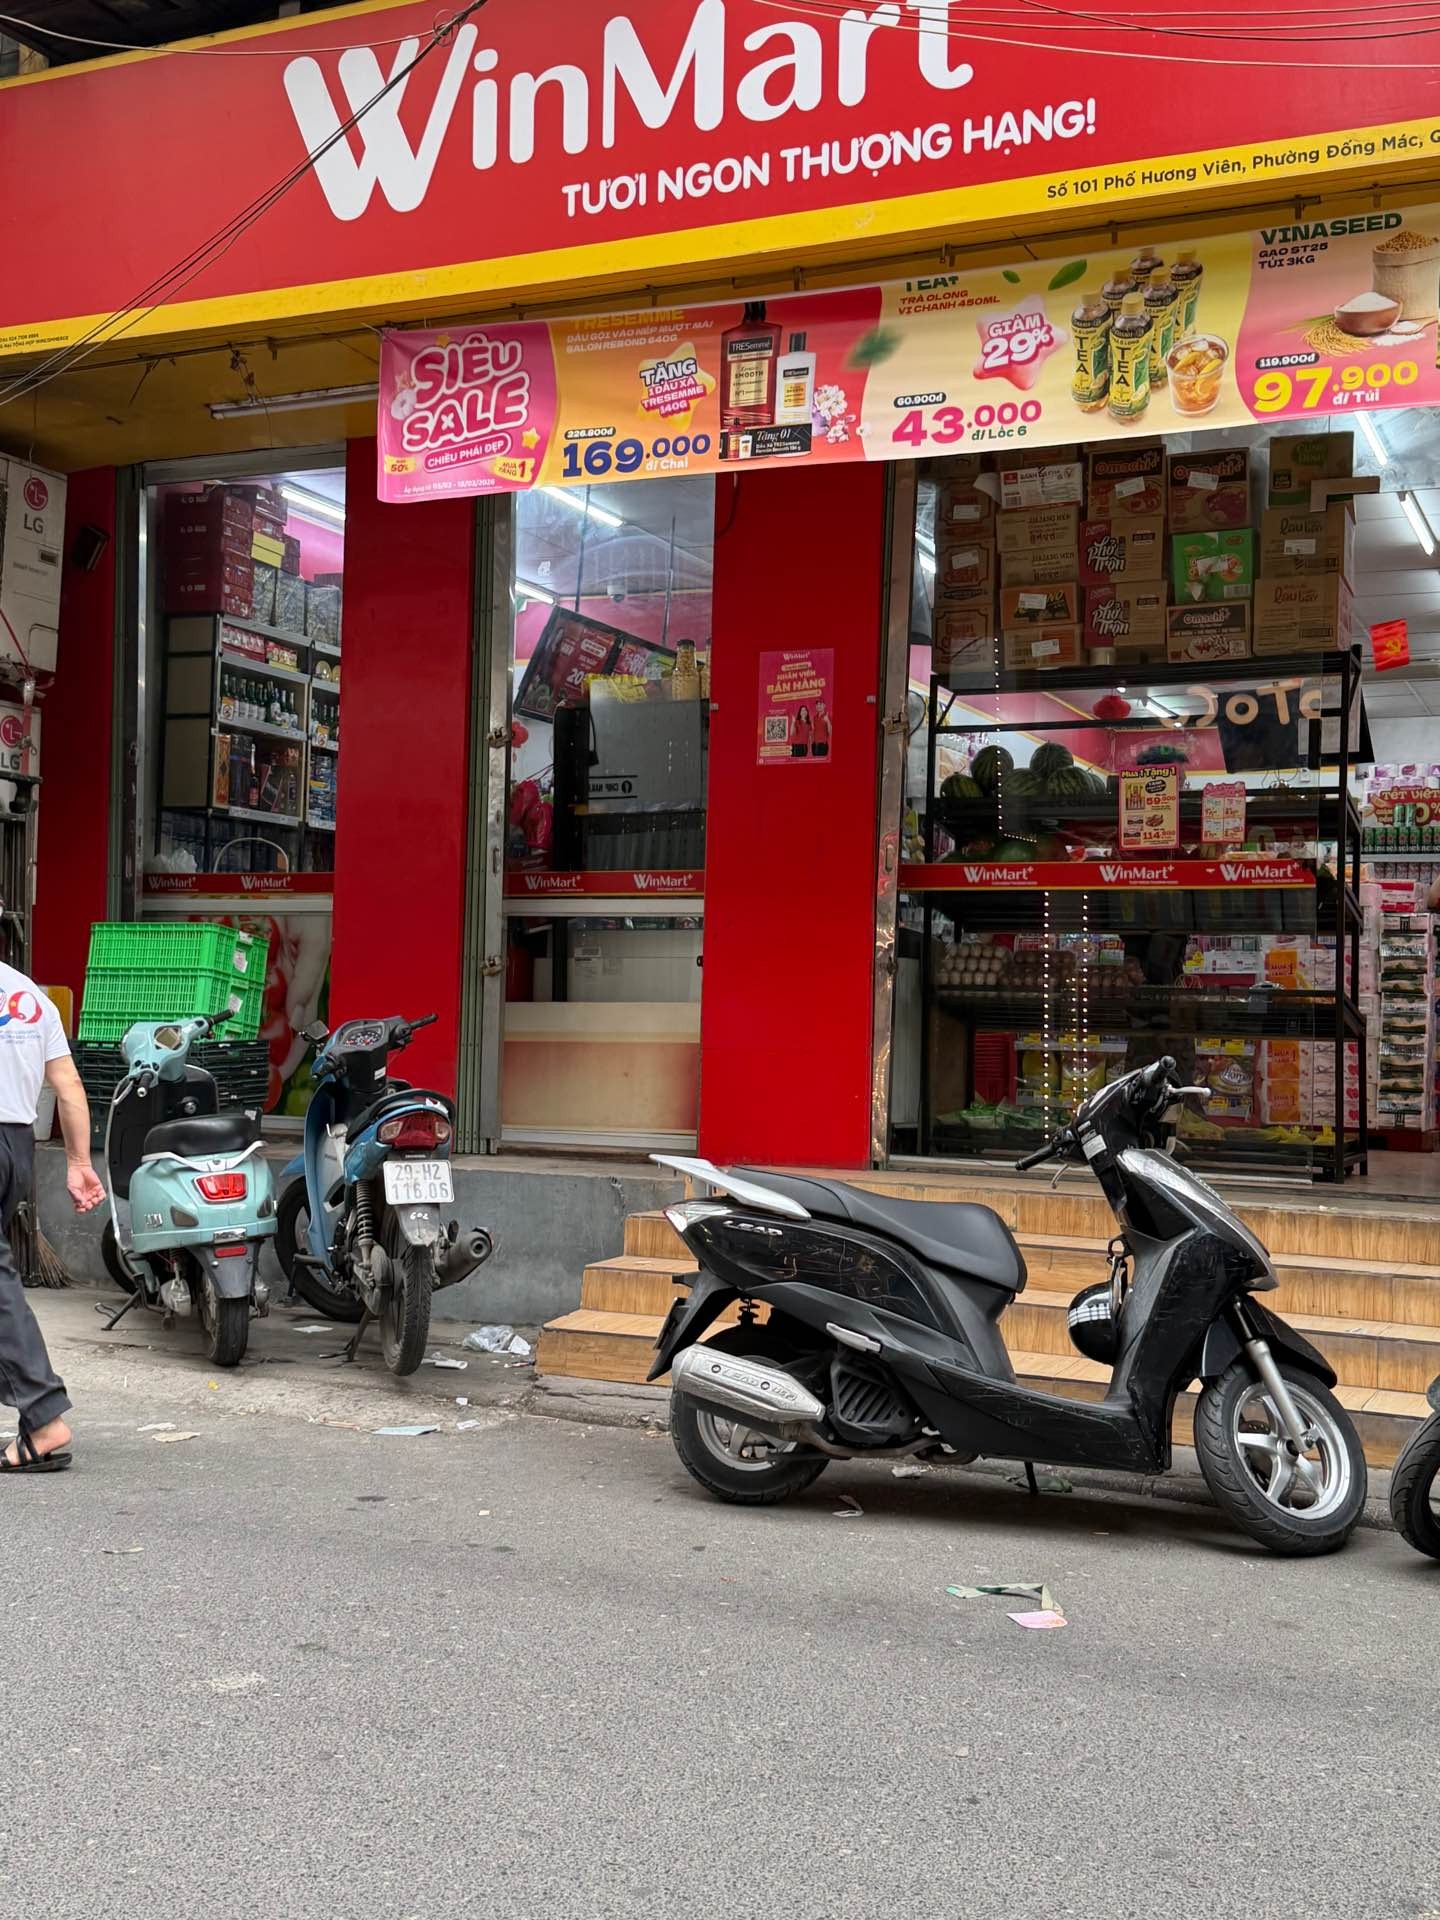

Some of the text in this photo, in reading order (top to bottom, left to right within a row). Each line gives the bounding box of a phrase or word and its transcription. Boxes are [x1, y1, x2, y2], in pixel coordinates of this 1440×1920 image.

[283, 0, 974, 221] WinMart
[562, 97, 1097, 217] TƯƠI NGON THƯỢNG HẠNG!
[1047, 180, 1068, 198] Số
[1073, 178, 1098, 195] 101
[1104, 170, 1136, 191] Phố
[1141, 165, 1197, 186] Hương
[1203, 158, 1247, 177] Viên,
[1252, 147, 1320, 170] Phường
[1382, 133, 1424, 153] Mác,
[1260, 213, 1403, 245] VINASEED
[1291, 242, 1328, 254] ST25
[1287, 255, 1315, 266] 3KG
[914, 301, 957, 314] CHANH
[957, 295, 1000, 308] 450ML
[566, 342, 602, 354] SALON
[983, 326, 1050, 369] 29%
[413, 333, 522, 407] SIÊU
[640, 358, 698, 386] TẶNG
[641, 385, 705, 409] TRESEMME
[1253, 359, 1419, 413] 97.900
[1352, 388, 1380, 403] Túi
[402, 371, 530, 452] SALE
[659, 400, 689, 414] 140G
[892, 399, 1042, 447] 43.000
[1017, 425, 1027, 436] 6
[562, 434, 711, 478] 169.000
[660, 456, 689, 470] Chai
[24, 513, 44, 535] LG
[1, 751, 20, 771] LG
[722, 1220, 783, 1236] LEAD
